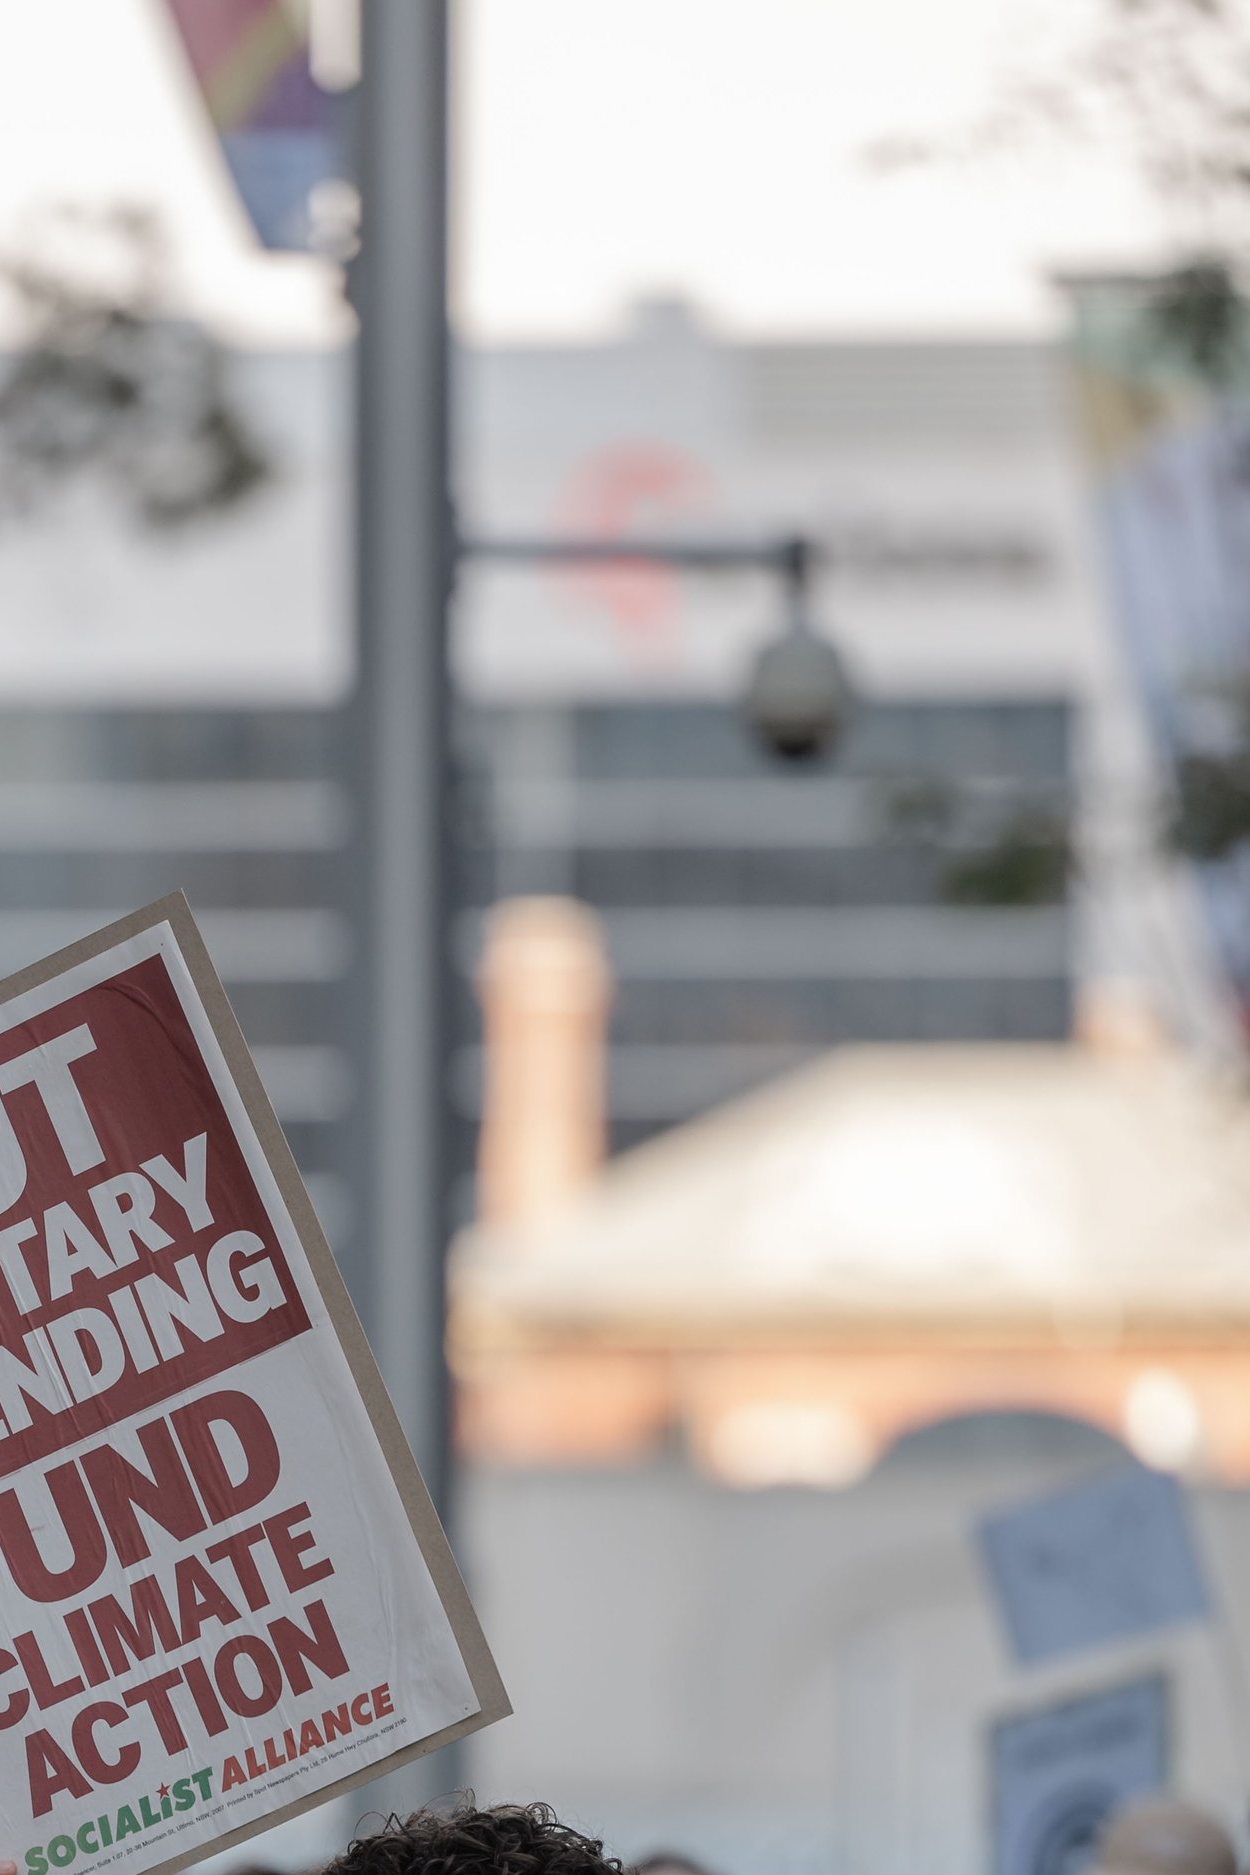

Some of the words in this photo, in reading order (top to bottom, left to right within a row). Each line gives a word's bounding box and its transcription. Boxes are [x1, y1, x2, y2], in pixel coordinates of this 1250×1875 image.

[25, 1599, 350, 1818] ACTION
[221, 1683, 394, 1792] ALLIANCE
[226, 1794, 246, 1808] Printed
[266, 1770, 299, 1789] Newspapers
[327, 1748, 344, 1760] Hume
